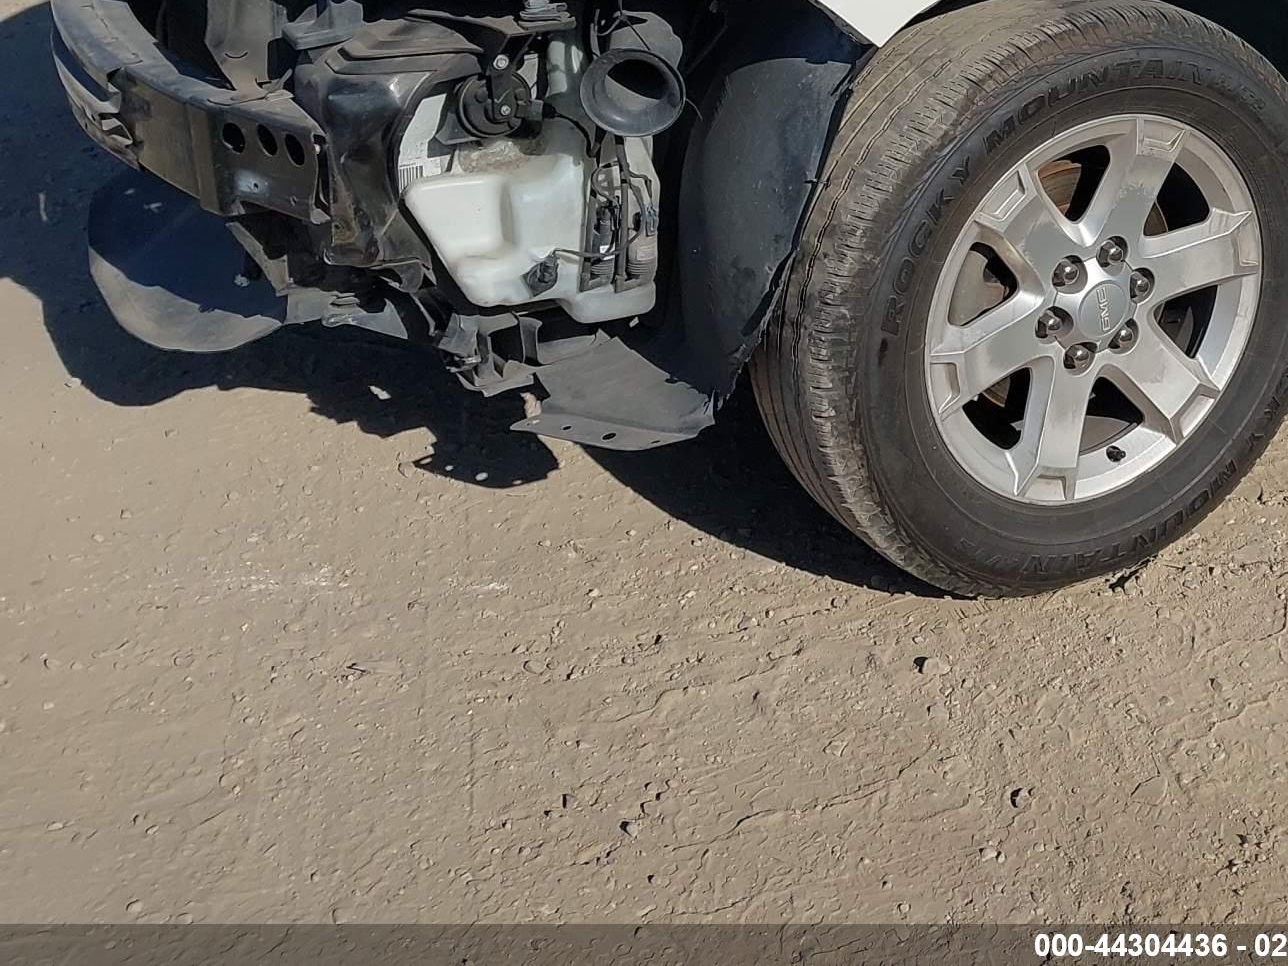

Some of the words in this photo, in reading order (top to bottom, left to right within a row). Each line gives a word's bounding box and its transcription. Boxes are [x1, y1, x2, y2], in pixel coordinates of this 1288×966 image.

[880, 154, 973, 336] ROCKY
[985, 57, 1211, 155] MOUNTAIN
[1096, 287, 1111, 332] GMC
[1021, 459, 1238, 575] MOUNTAIN
